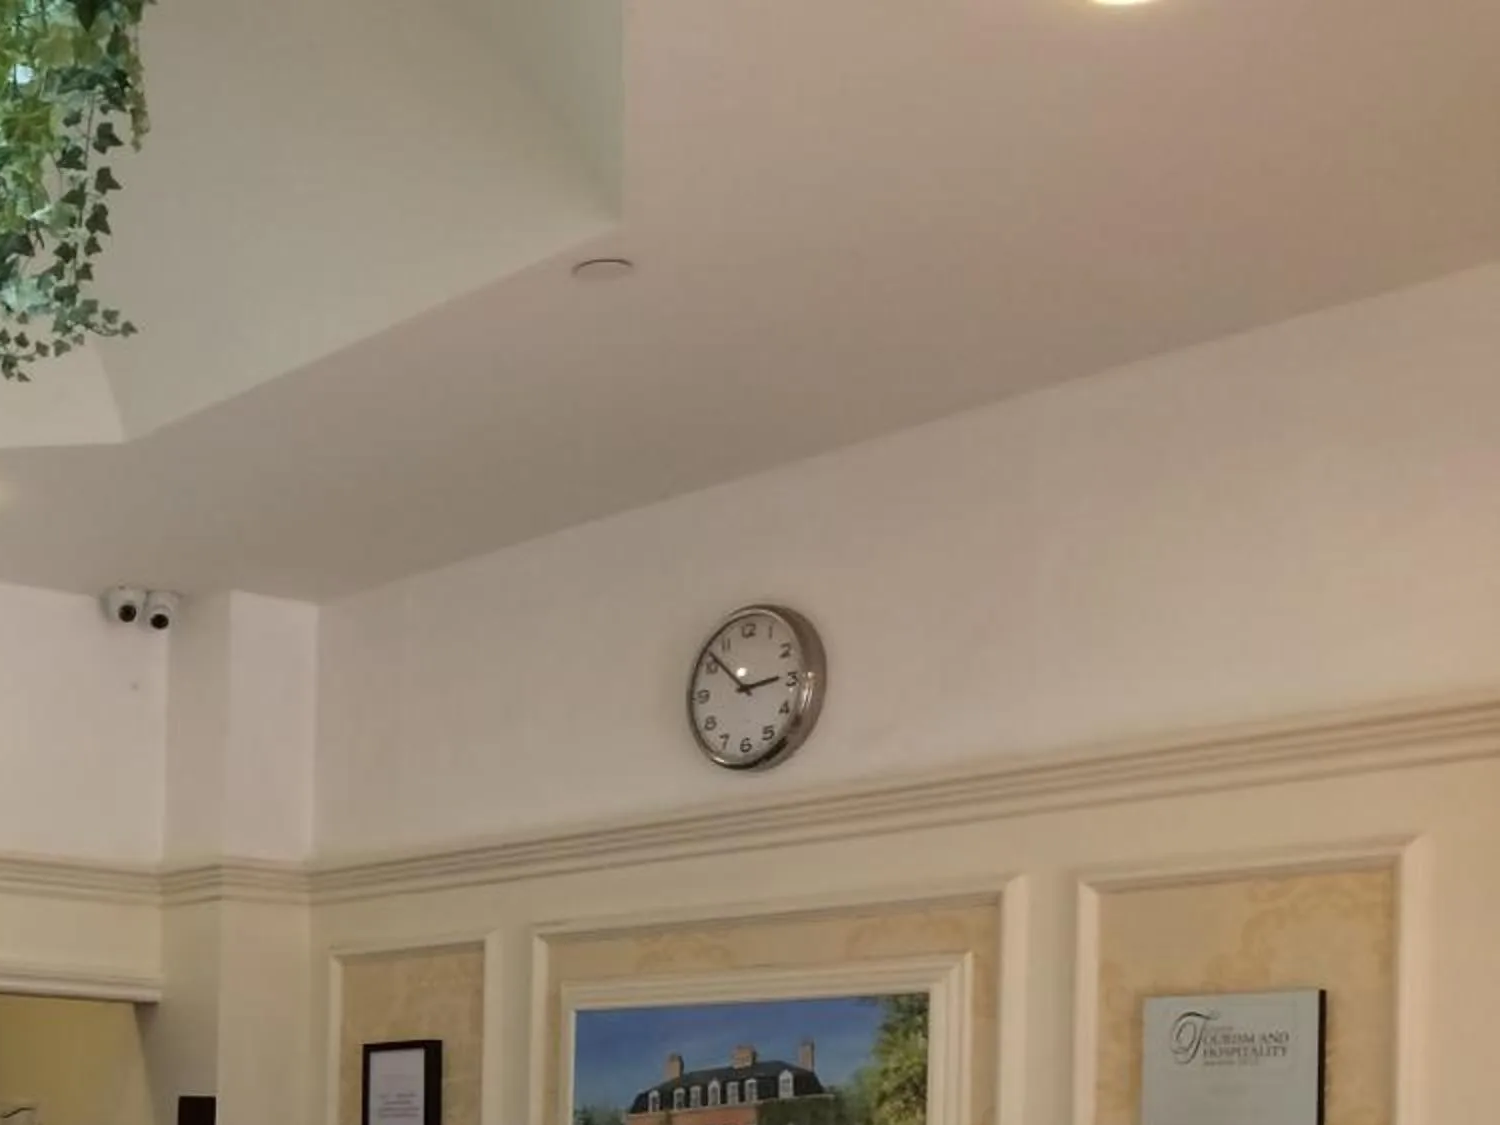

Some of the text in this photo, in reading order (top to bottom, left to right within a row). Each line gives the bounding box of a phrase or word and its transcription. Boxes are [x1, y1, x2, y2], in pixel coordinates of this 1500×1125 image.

[741, 622, 757, 639] 12
[768, 625, 774, 639] 1
[721, 638, 731, 652] 11
[779, 643, 792, 658] 2
[705, 661, 719, 675] 10
[786, 671, 798, 687] 3
[696, 689, 710, 704] 9
[778, 699, 790, 715] 4
[704, 715, 717, 731] 8
[762, 725, 775, 741] 5
[719, 733, 730, 750] 7
[739, 737, 752, 753] 6
[1203, 1045, 1288, 1059] HOSPITALITY
